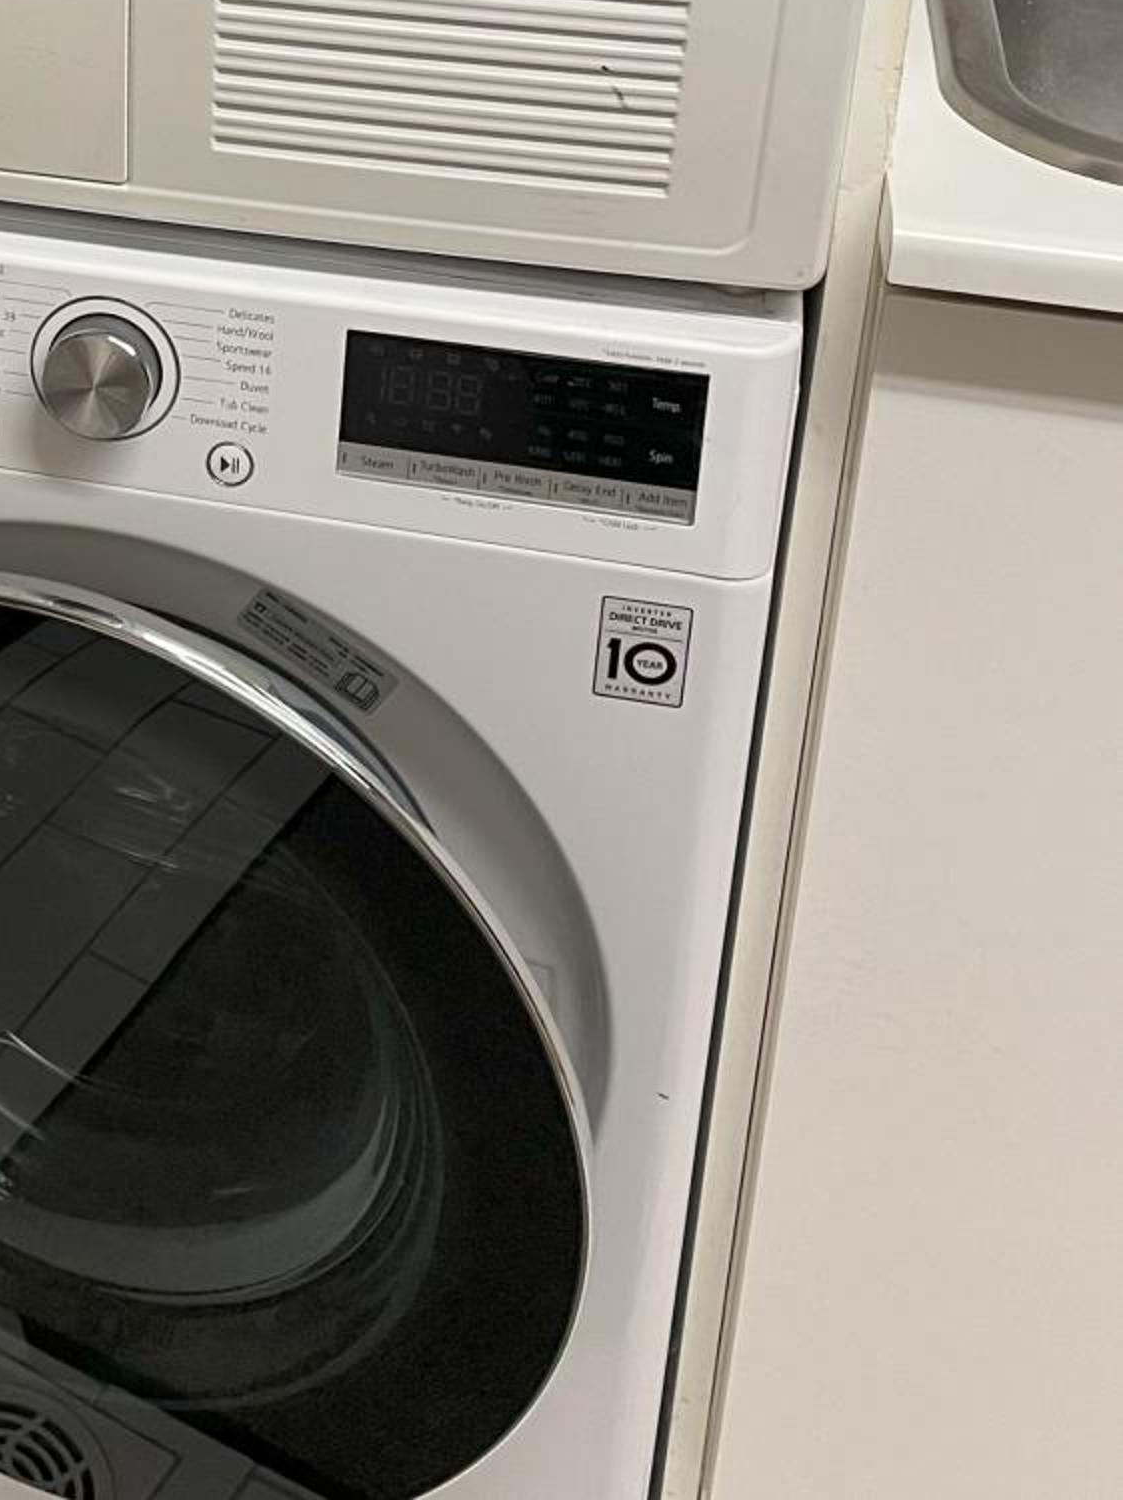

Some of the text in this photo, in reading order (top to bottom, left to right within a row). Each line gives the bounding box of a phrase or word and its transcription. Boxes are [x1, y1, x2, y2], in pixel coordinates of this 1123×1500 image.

[228, 308, 276, 324] Delicates
[217, 326, 274, 341] Hand/Wool
[217, 342, 272, 358] Sportswear
[226, 361, 256, 375] Speed
[240, 381, 269, 393] Duvet
[220, 398, 270, 414] Tub Clean
[190, 413, 269, 433] Download Cycle
[361, 455, 394, 469] Steam
[649, 450, 674, 465] Spin
[595, 484, 616, 497] End
[609, 611, 683, 631] DIRECT DRIVE
[607, 637, 677, 686] 10
[637, 658, 664, 670] YEAR
[604, 684, 672, 699] WARRANTY
